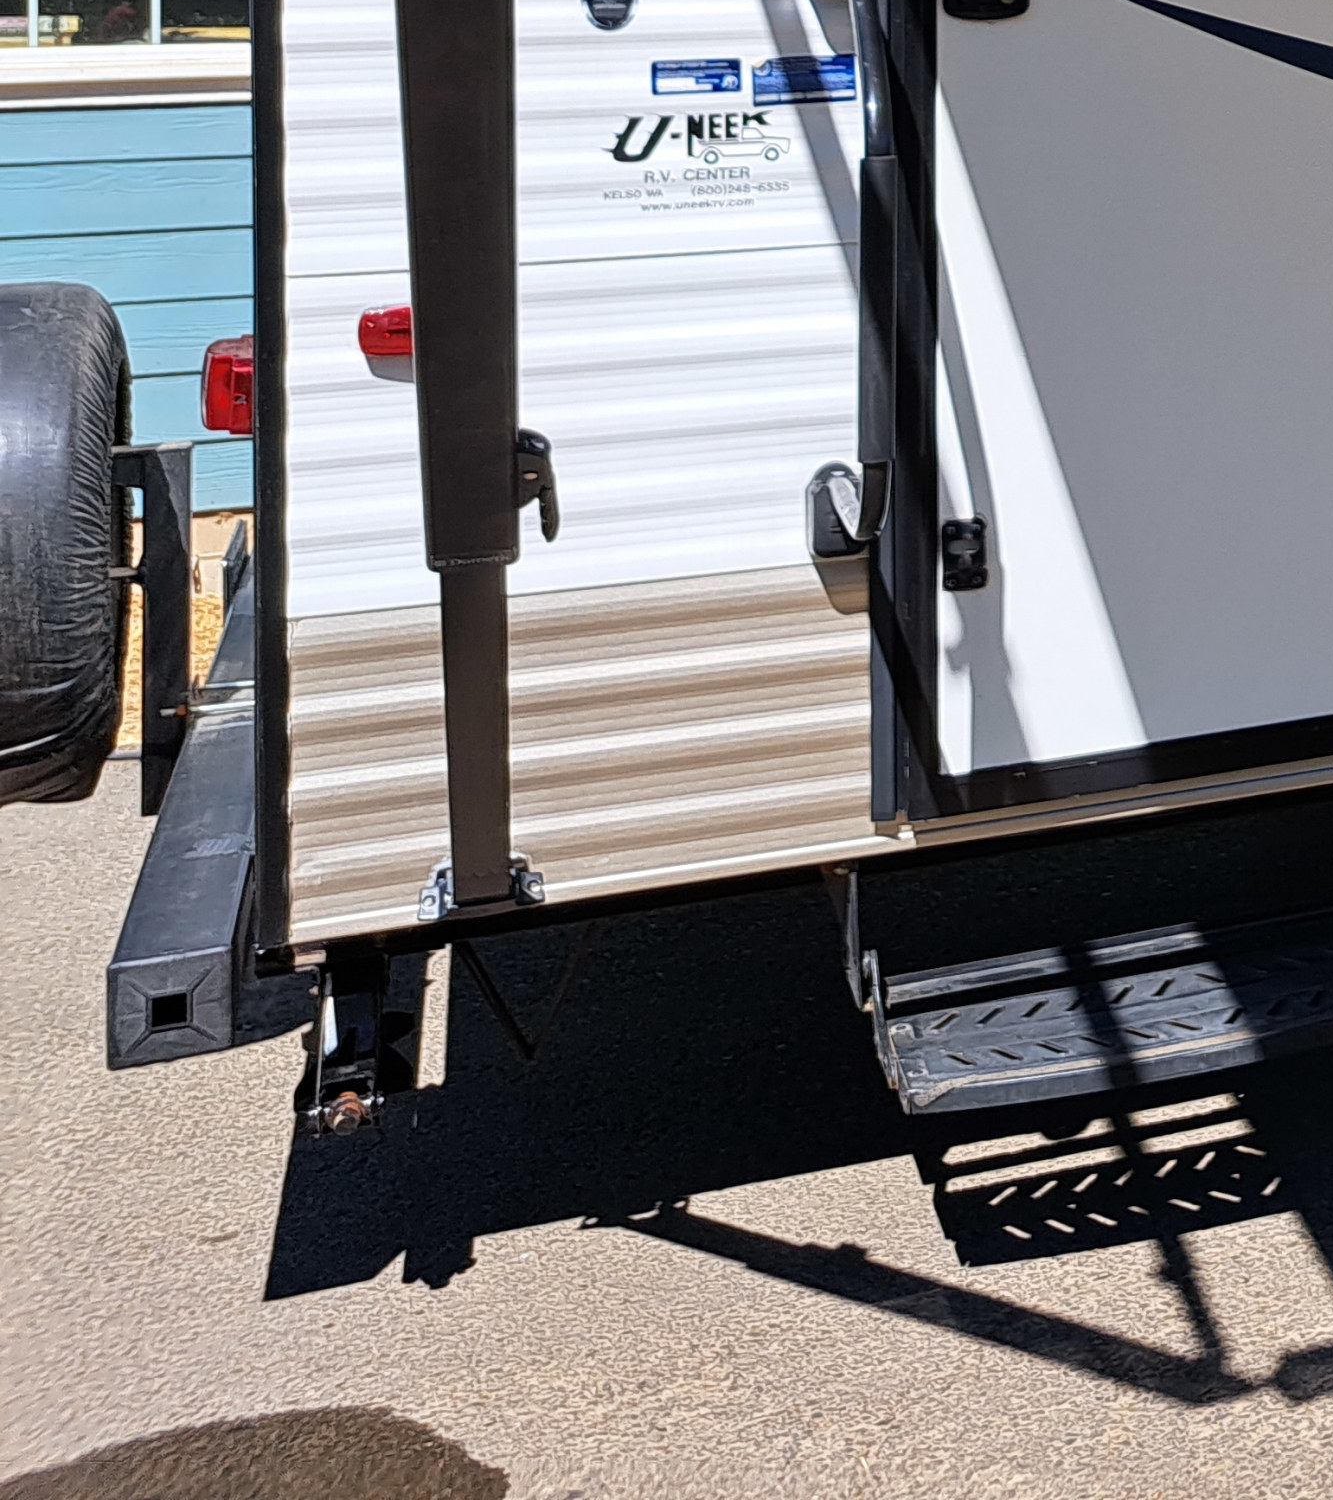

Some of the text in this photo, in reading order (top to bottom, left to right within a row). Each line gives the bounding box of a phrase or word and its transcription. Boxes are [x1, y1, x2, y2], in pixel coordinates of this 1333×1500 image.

[601, 110, 773, 162] U-NEEK
[644, 166, 751, 183] R.V. CENTER
[604, 189, 642, 200] KELSO
[646, 188, 664, 198] WA
